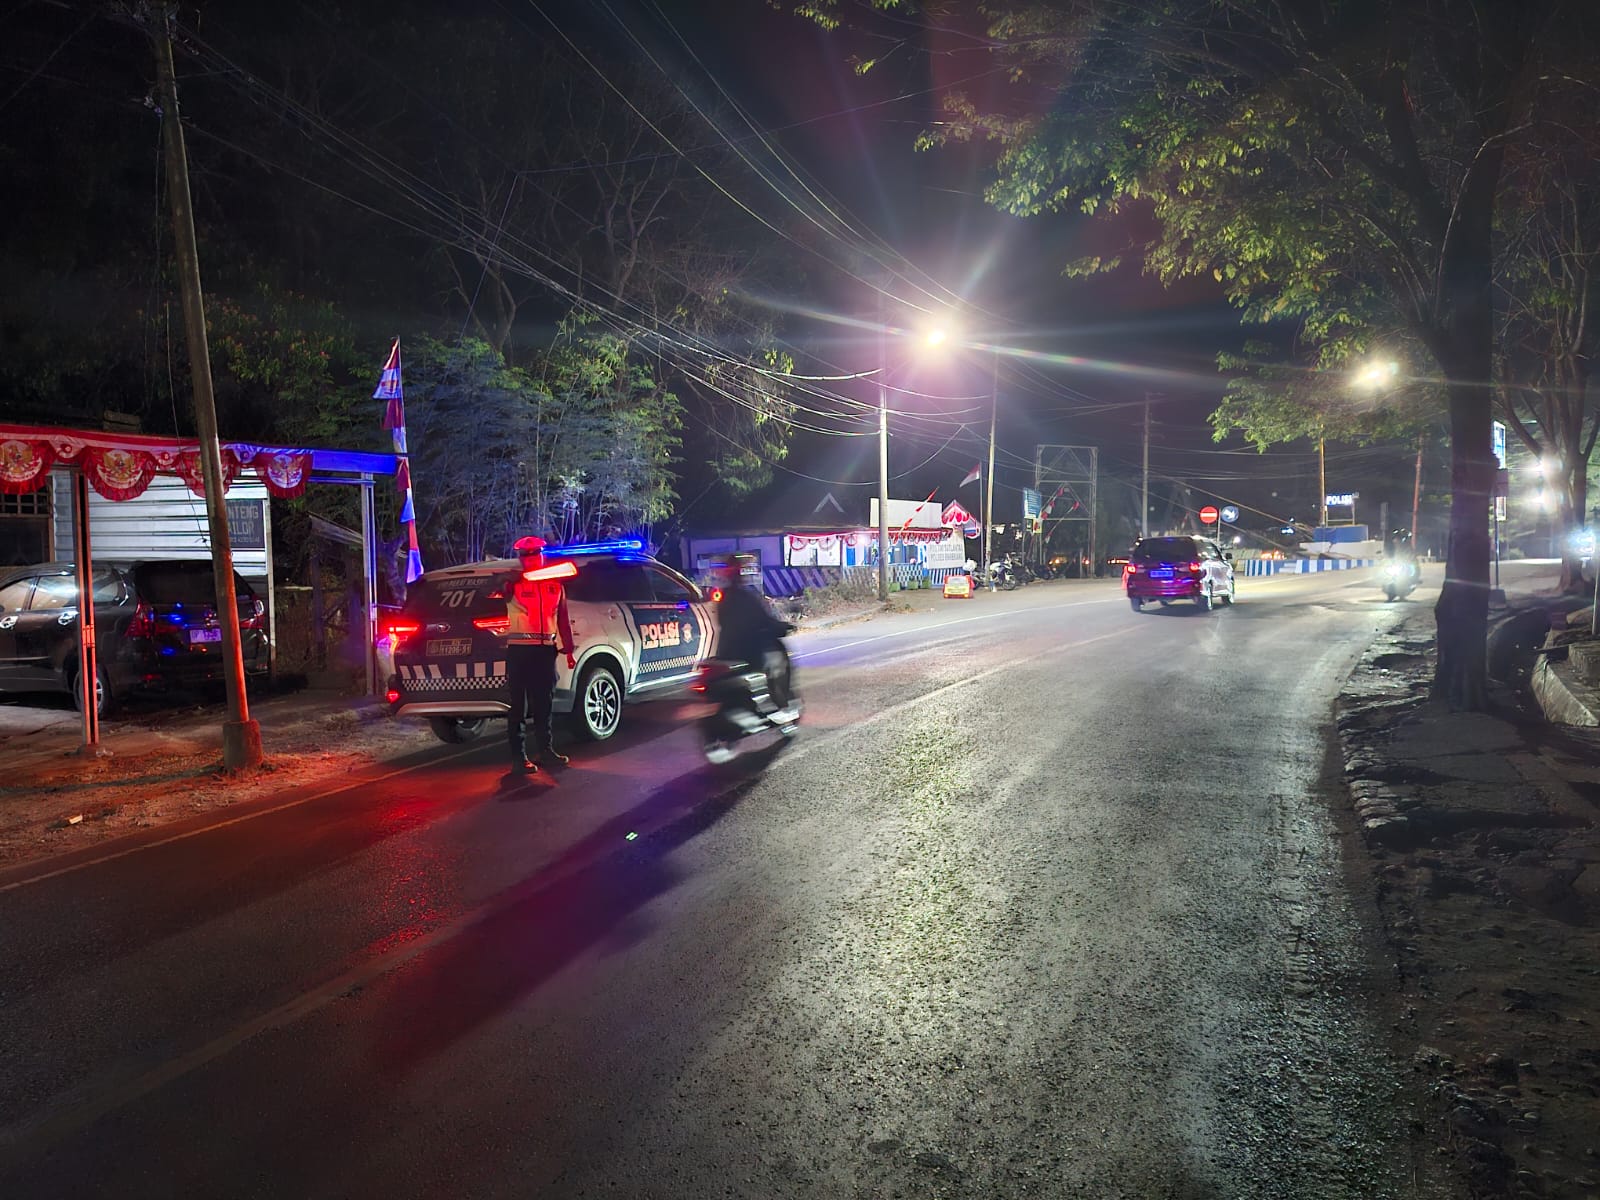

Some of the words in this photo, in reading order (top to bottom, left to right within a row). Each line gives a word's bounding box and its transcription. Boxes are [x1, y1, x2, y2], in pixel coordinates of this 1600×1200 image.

[1326, 494, 1353, 506] POLISI
[440, 589, 477, 608] 701
[640, 621, 680, 641] POLISI
